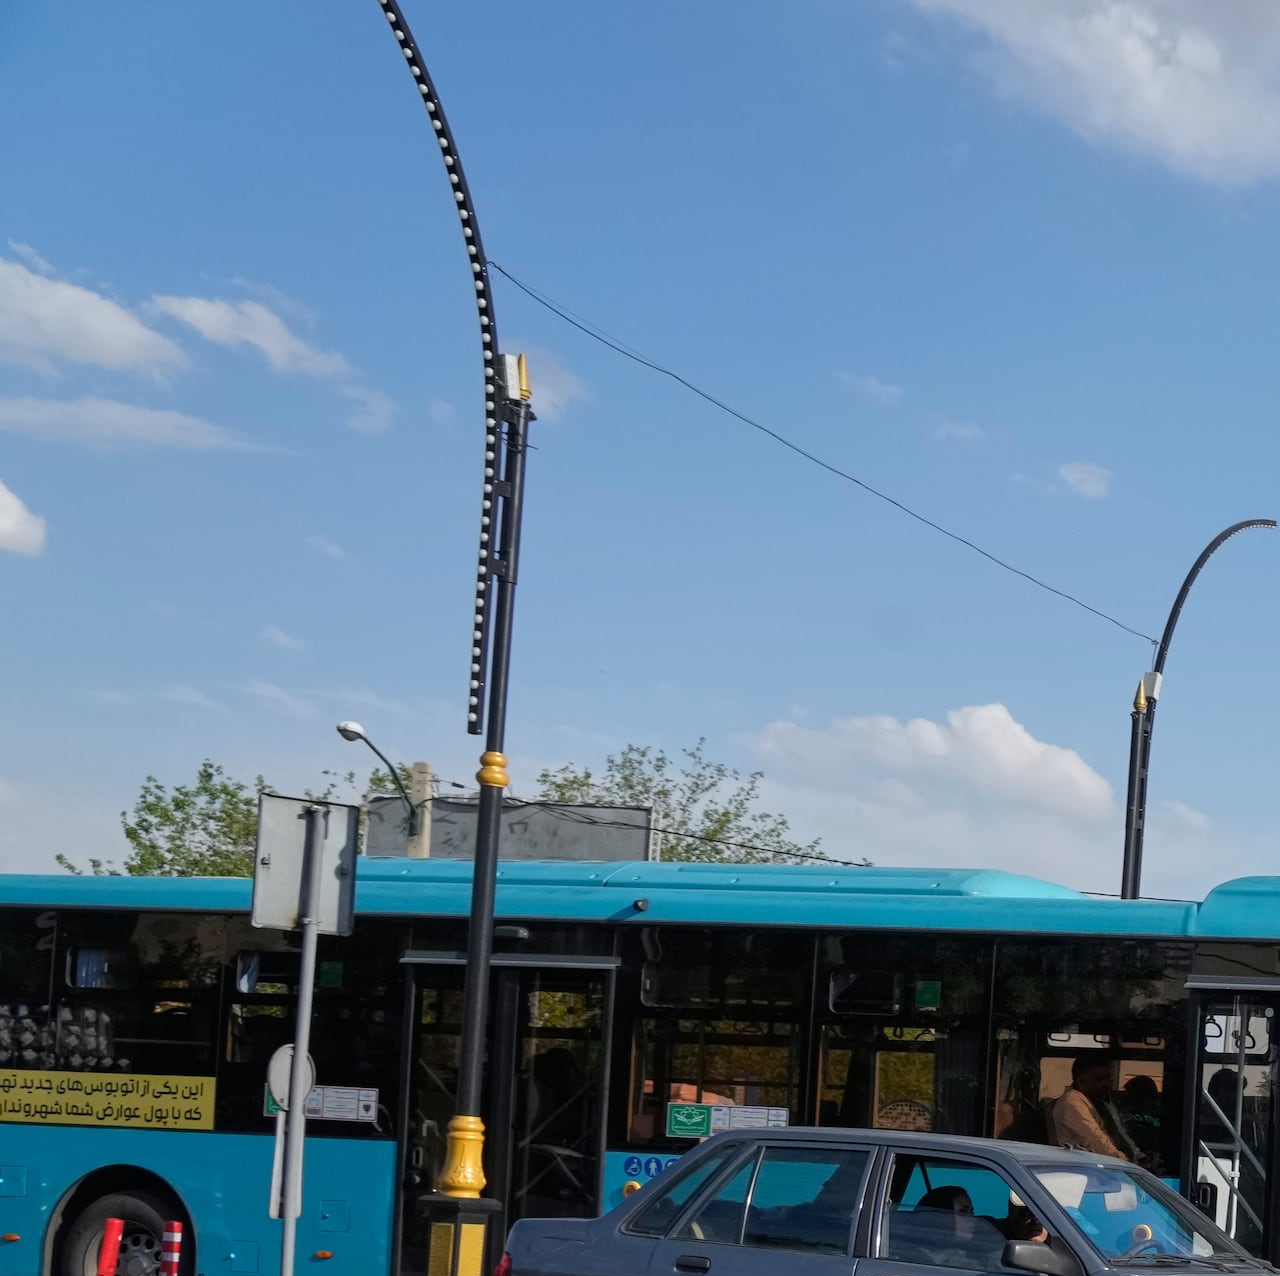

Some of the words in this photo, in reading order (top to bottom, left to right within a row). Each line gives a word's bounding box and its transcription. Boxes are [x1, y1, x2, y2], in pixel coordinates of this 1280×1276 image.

[0, 1074, 17, 1093] ته
[20, 1078, 53, 1095] جدید
[140, 1079, 150, 1097] از
[152, 1080, 179, 1099] یکی
[181, 1082, 204, 1100] این
[0, 1098, 63, 1119] شهروندا
[65, 1101, 94, 1117] شما
[96, 1101, 141, 1121] عوارض
[144, 1105, 169, 1126] پول
[171, 1105, 181, 1125] با
[184, 1106, 202, 1121] که
